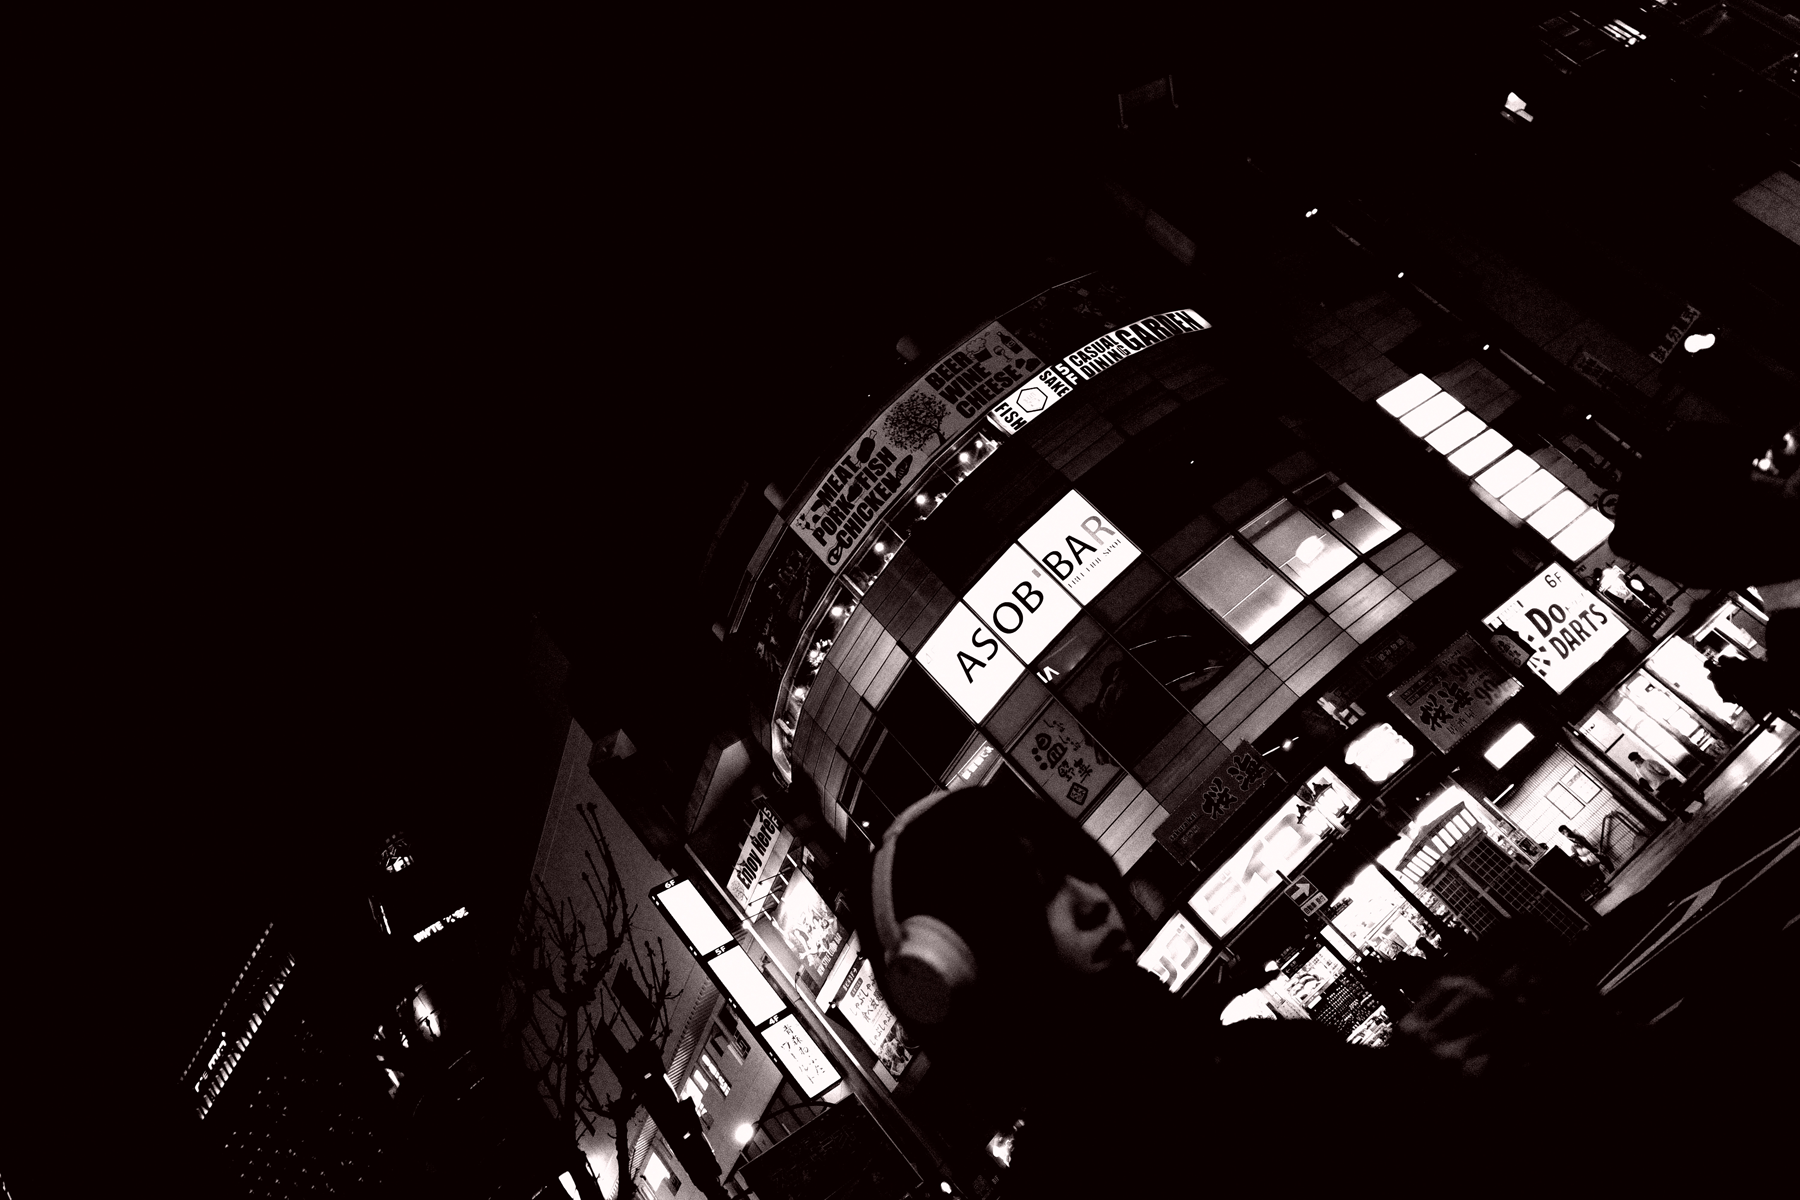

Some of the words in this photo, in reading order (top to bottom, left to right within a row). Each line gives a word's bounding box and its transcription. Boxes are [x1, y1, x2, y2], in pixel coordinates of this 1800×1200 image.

[1069, 335, 1119, 367] CASUAL
[1115, 310, 1204, 351] GARDEN
[925, 351, 973, 392] BEER
[1055, 362, 1078, 386] 5F
[1079, 345, 1131, 379] DINING
[939, 362, 992, 405] WINE
[956, 365, 1023, 419] CHEESE
[1039, 370, 1070, 398] SAKE
[994, 402, 1028, 431] FISH
[812, 494, 855, 546] PORK
[858, 446, 897, 491] FISH
[816, 455, 860, 500] MEAT
[836, 473, 903, 549] CHICKEN
[1041, 515, 1116, 581] BAR
[1543, 571, 1563, 588] 6F
[1525, 603, 1566, 638] Do
[1548, 603, 1608, 660] DARTS
[1419, 680, 1474, 732] 桜海
[1202, 752, 1267, 820] 桜海
[763, 806, 780, 828] 5F
[664, 879, 676, 890] 6F
[736, 847, 761, 890] Enjoy
[714, 945, 727, 957] 5F
[768, 1015, 780, 1026] 4F
